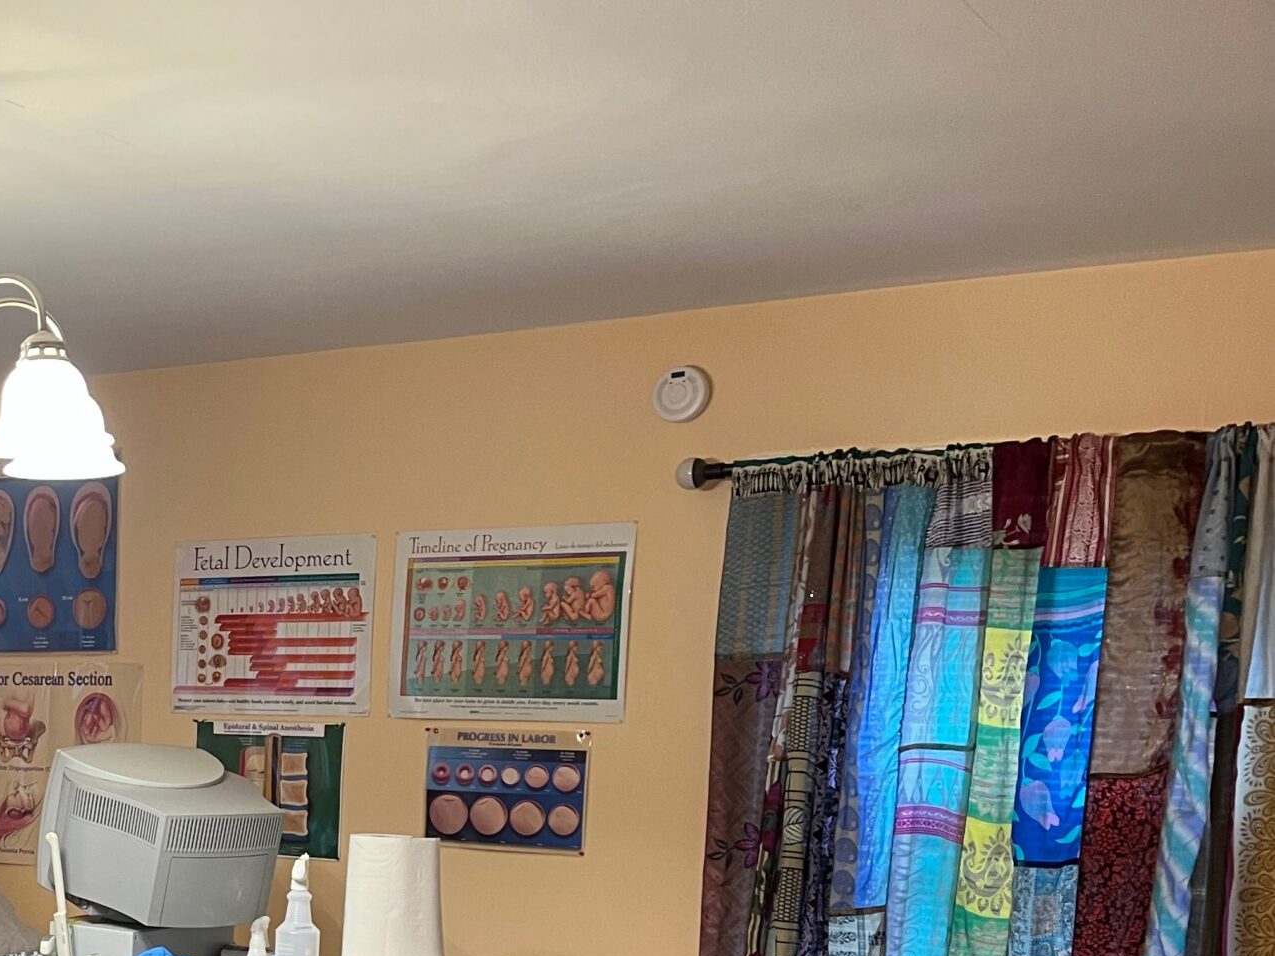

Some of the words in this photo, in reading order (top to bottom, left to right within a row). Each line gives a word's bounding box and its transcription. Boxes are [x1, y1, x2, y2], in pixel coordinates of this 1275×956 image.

[409, 536, 461, 554] Timeline
[464, 534, 478, 553] of
[481, 534, 548, 554] Pregnancy
[194, 546, 229, 571] Fetal
[235, 543, 353, 572] Development
[12, 673, 64, 686] Cesarean
[68, 672, 113, 686] Section
[224, 723, 251, 731] Epidural
[259, 723, 278, 731] Spinal
[457, 732, 505, 742] PROGRESS
[508, 733, 519, 743] IN
[522, 734, 556, 744] LABOR
